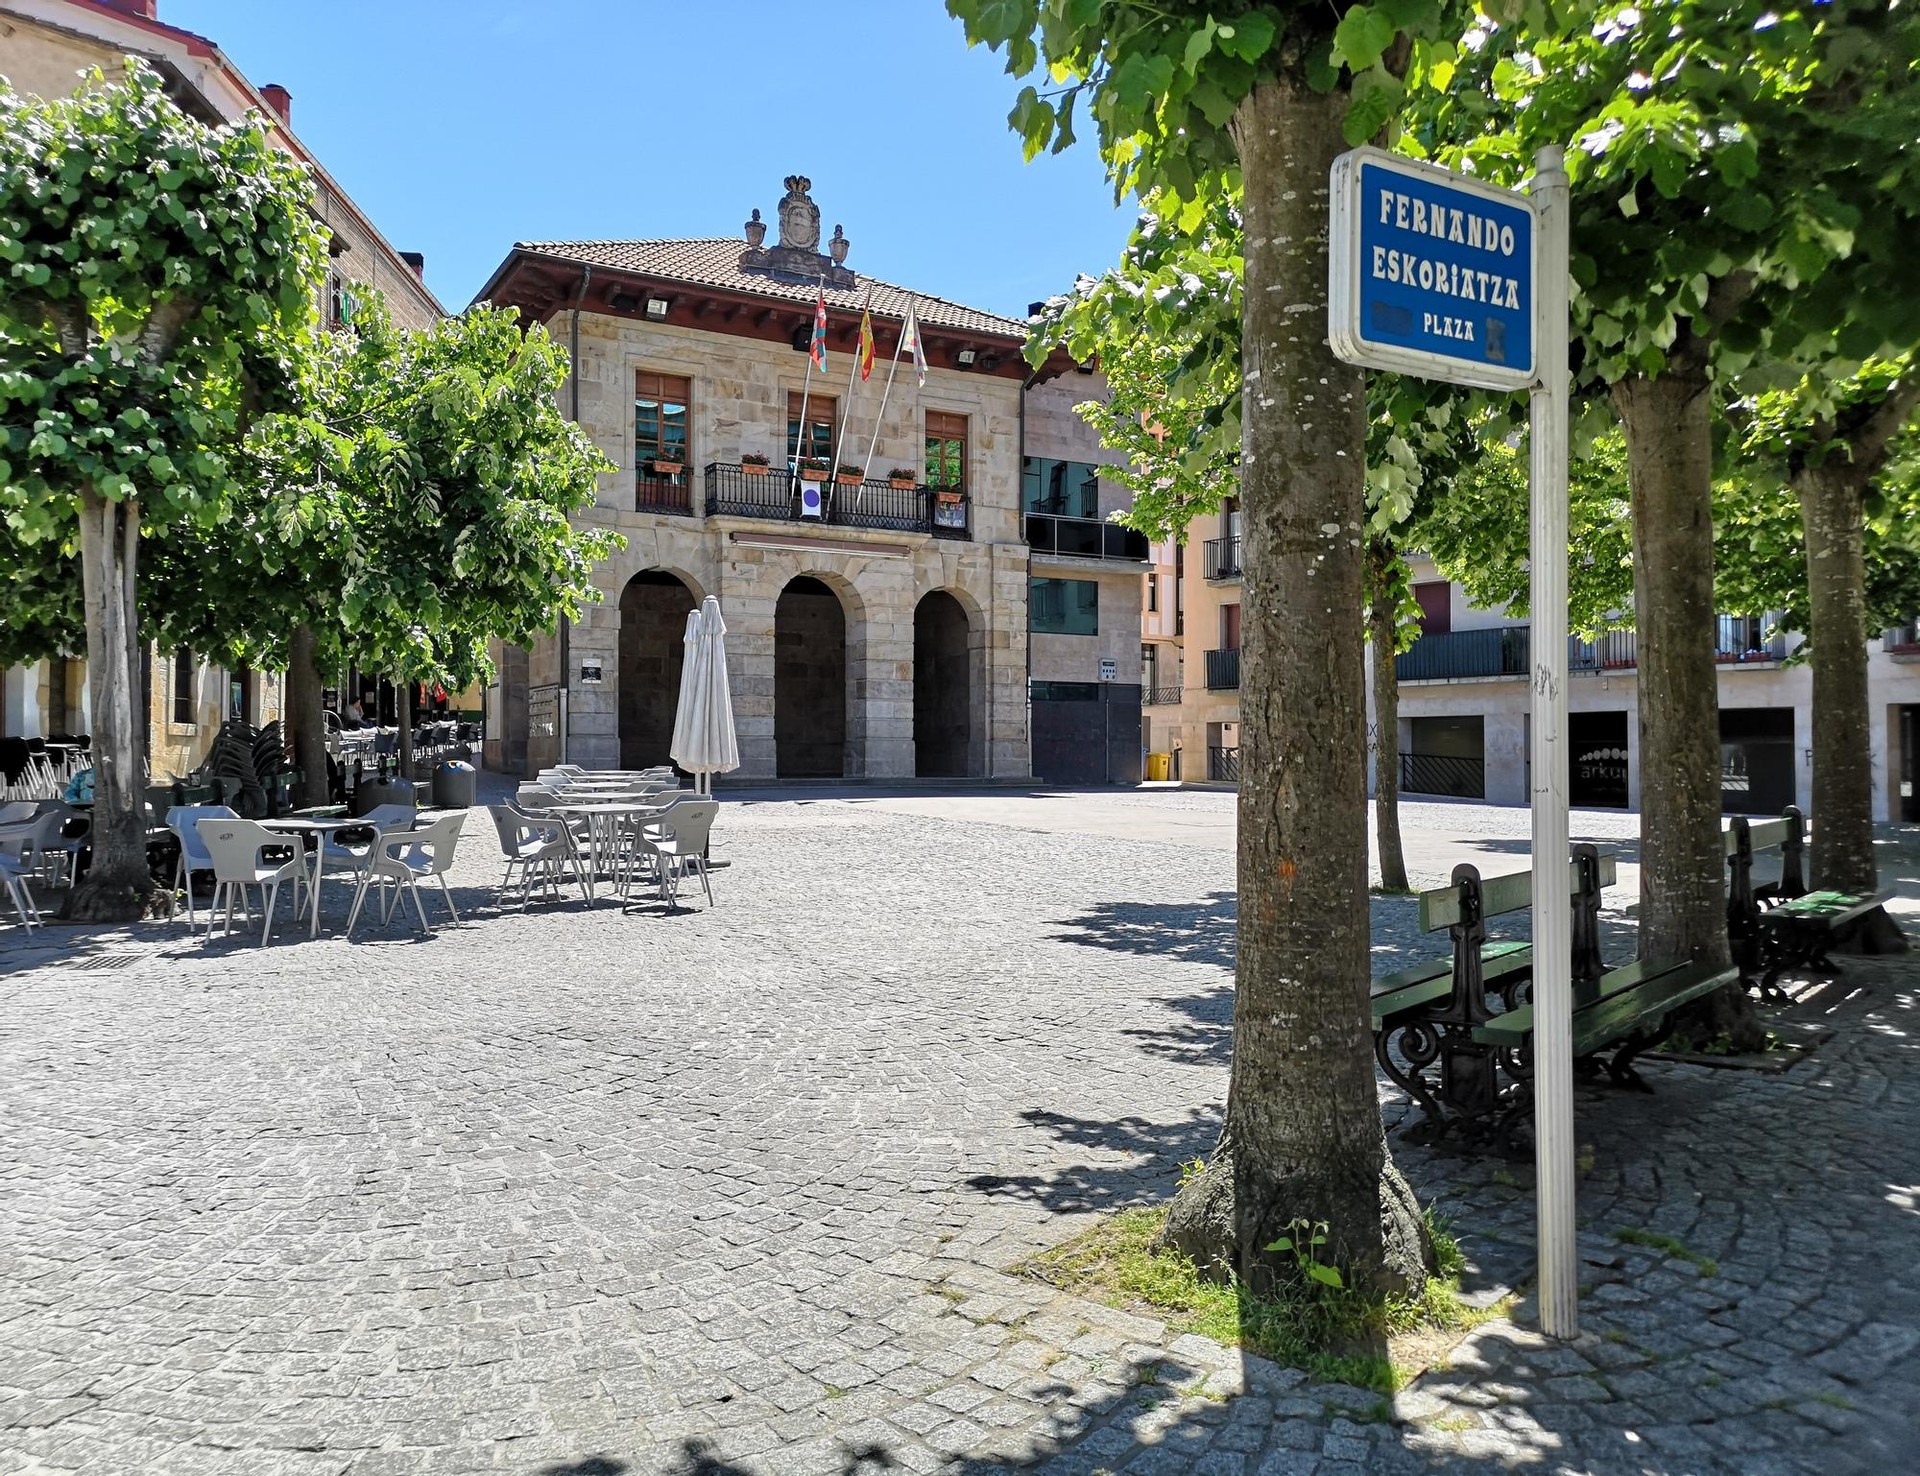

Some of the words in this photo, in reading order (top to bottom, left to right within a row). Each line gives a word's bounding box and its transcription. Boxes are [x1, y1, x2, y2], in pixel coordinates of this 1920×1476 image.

[1380, 189, 1515, 257] FERNANDO
[1372, 245, 1520, 310] ESKORIATZA
[1423, 312, 1475, 342] PLAZA
